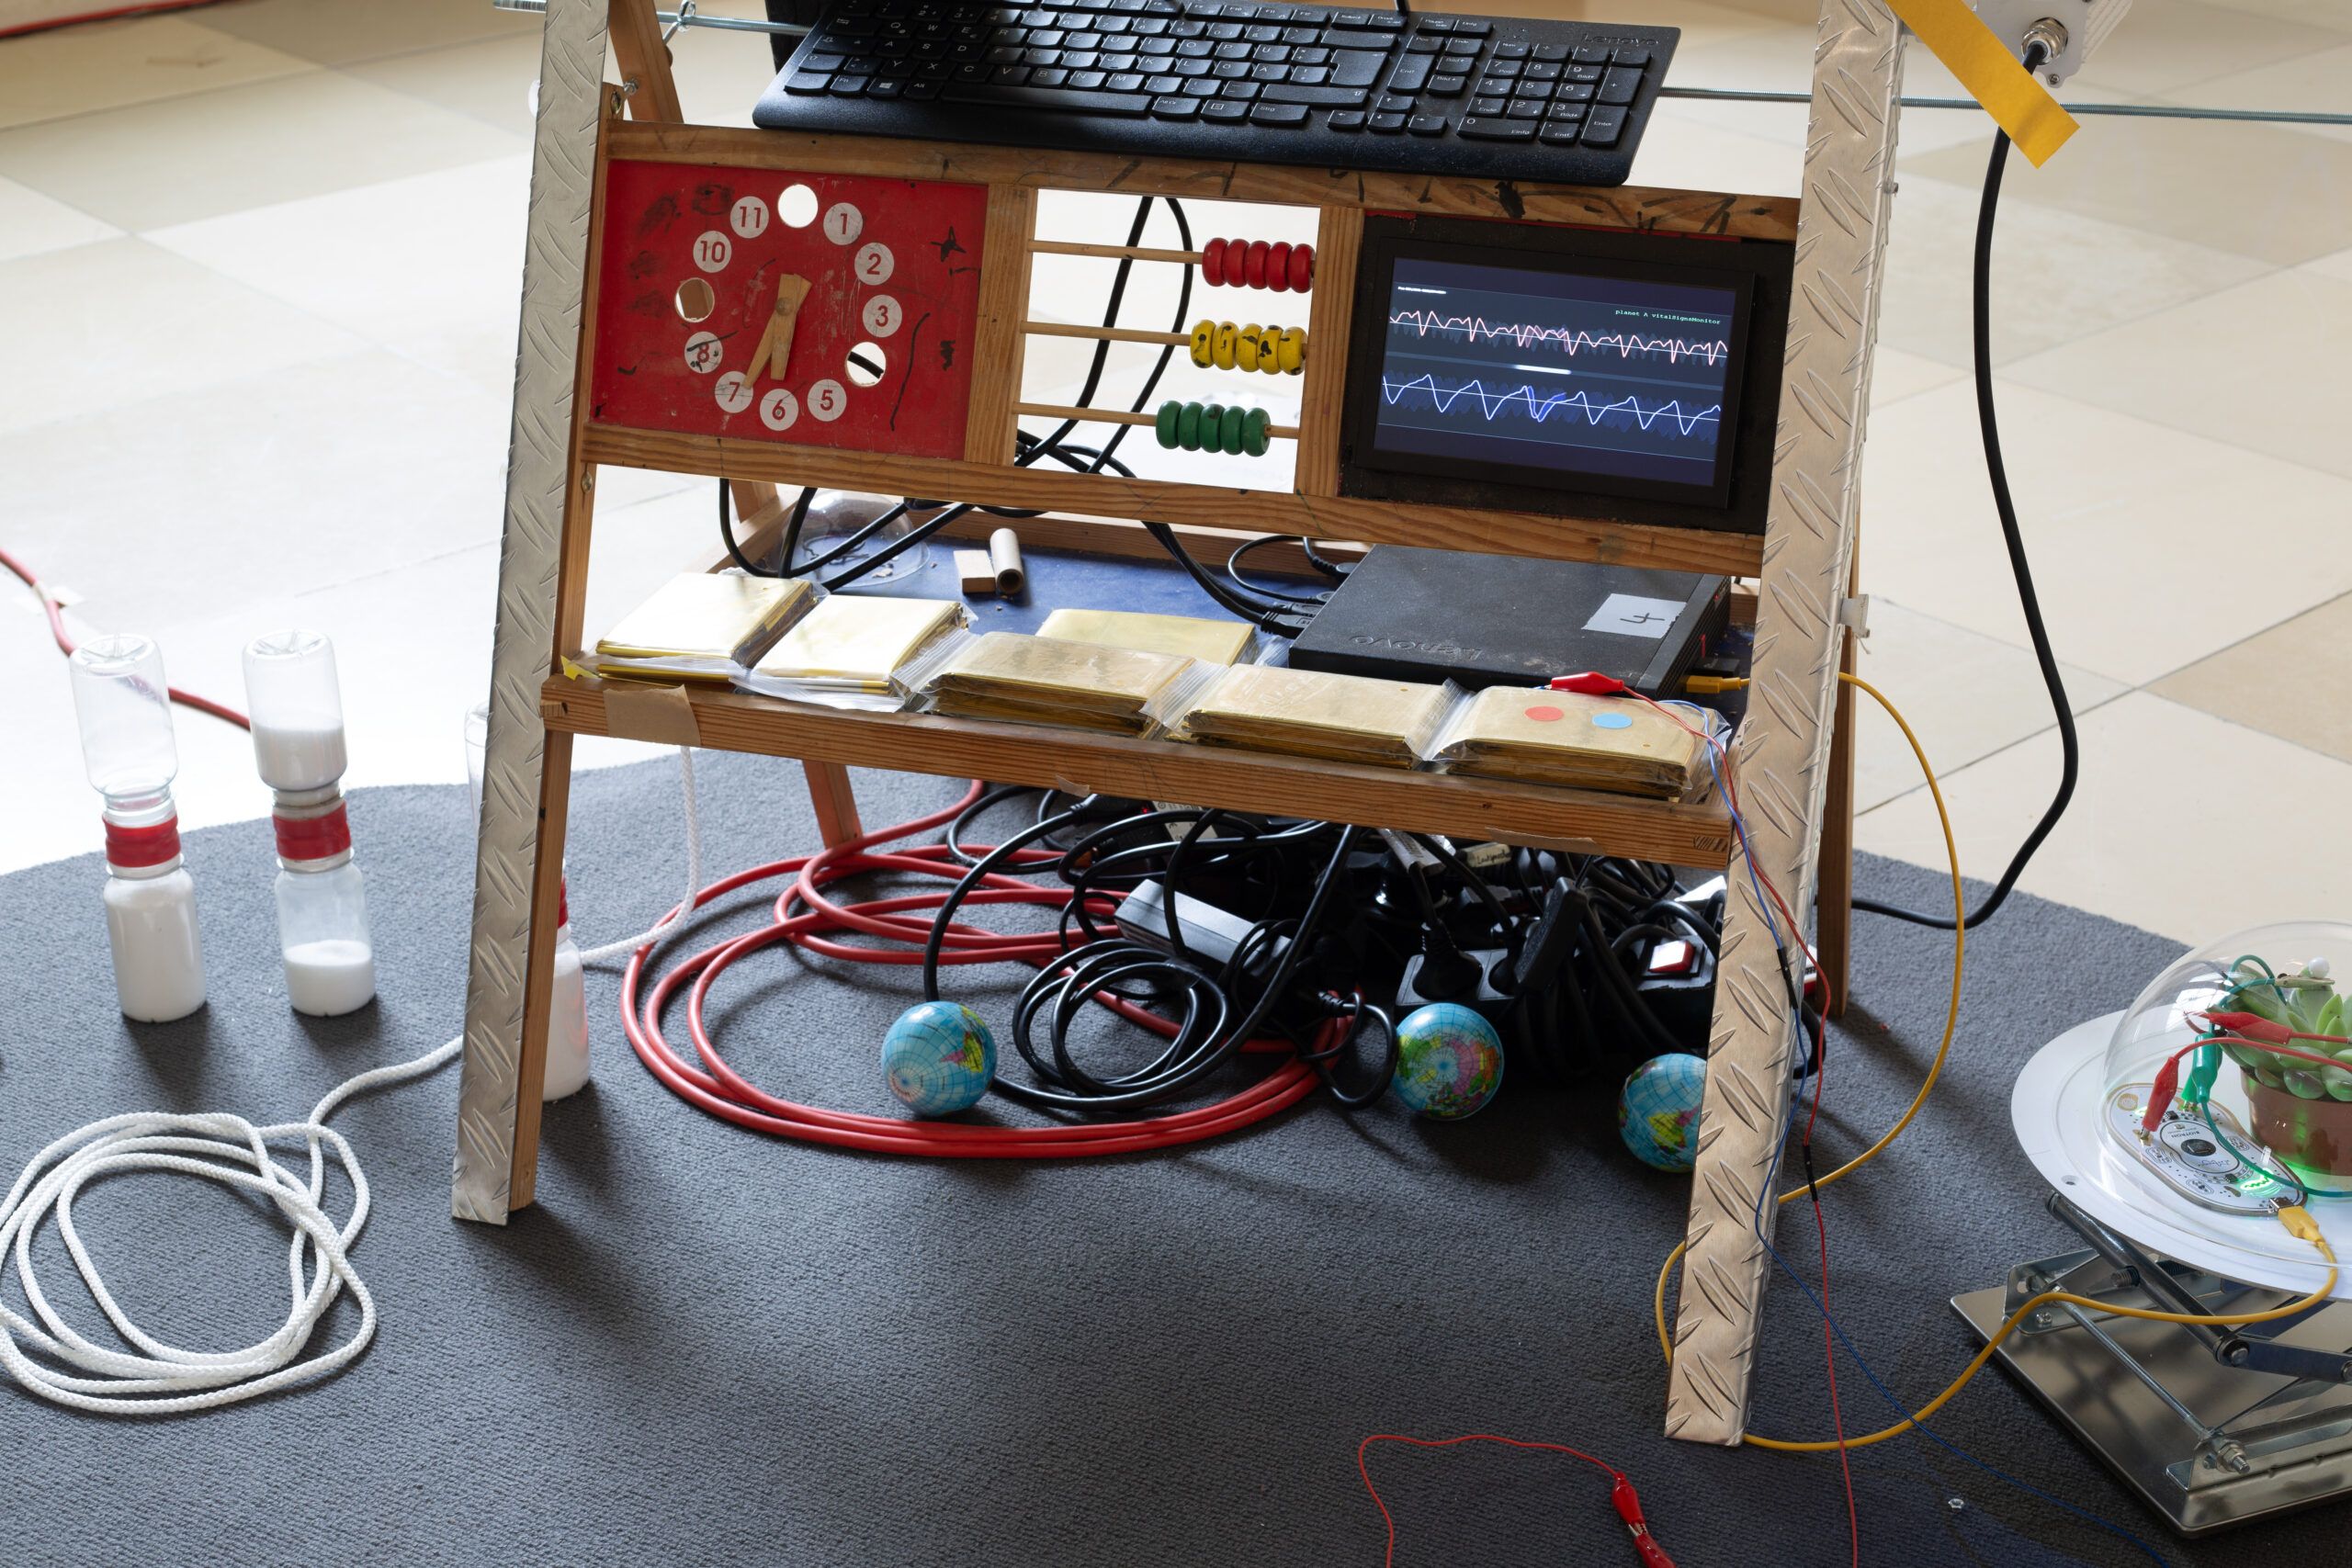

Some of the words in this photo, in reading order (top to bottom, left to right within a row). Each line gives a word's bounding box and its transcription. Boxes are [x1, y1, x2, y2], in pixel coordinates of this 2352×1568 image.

[1580, 33, 1659, 46] Lenovo
[739, 206, 763, 229] 11
[839, 212, 849, 235] 1
[700, 240, 726, 263] 10
[866, 253, 881, 276] 2
[875, 305, 888, 328] 3
[696, 342, 710, 365] 8
[729, 381, 741, 403] 7
[820, 389, 834, 411] 5
[772, 399, 786, 421] 6
